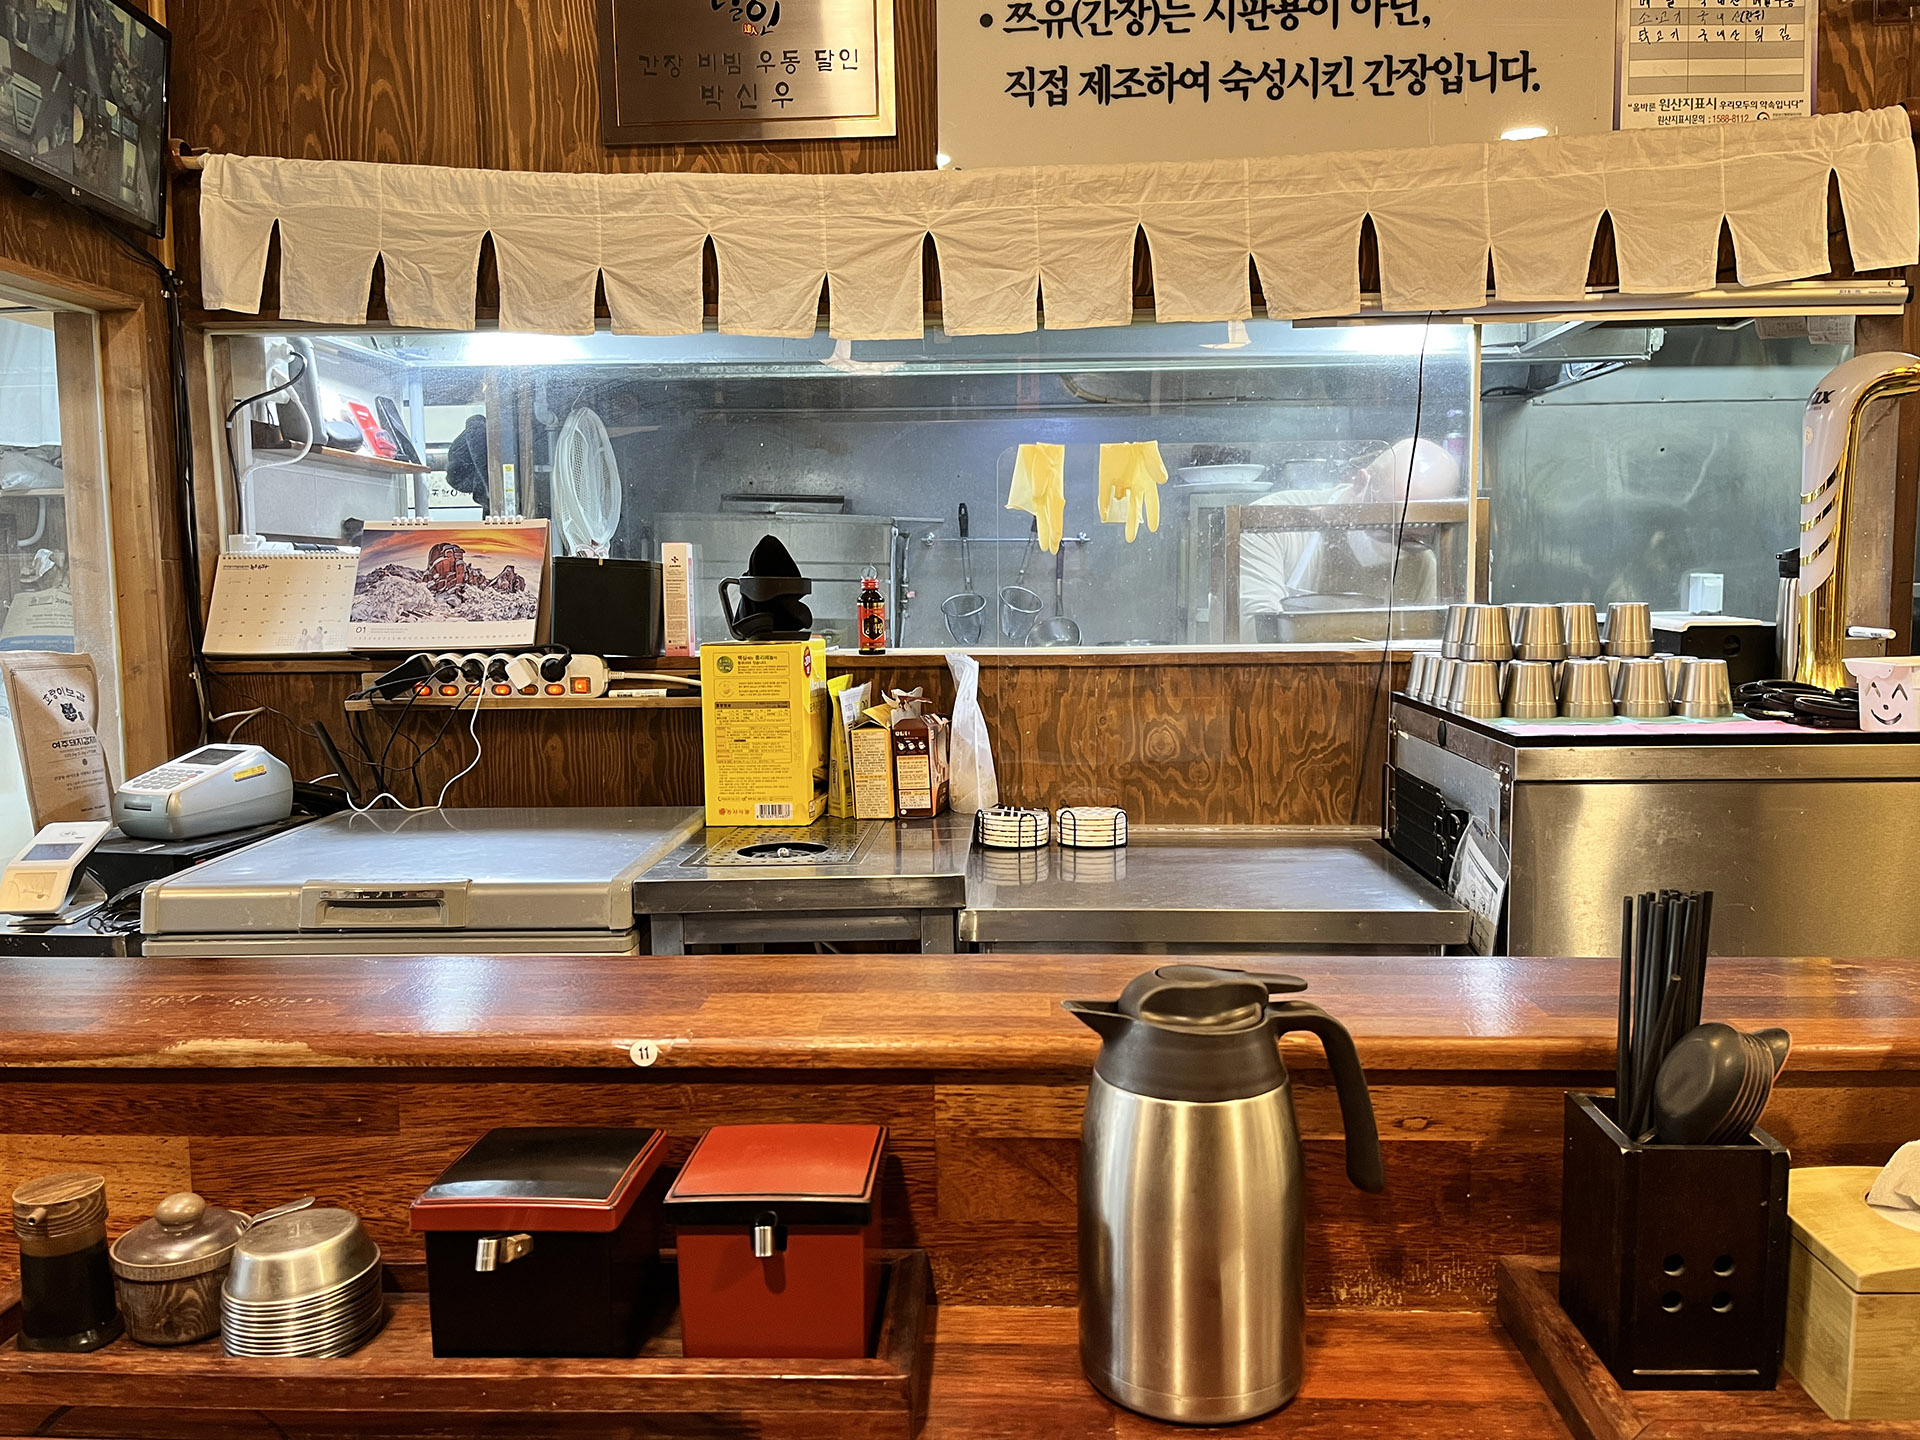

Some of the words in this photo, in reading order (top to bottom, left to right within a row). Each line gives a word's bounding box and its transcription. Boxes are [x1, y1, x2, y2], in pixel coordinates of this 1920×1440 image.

[1002, 0, 1195, 39] 쯔유(간장)는
[639, 54, 683, 78] 간장
[697, 52, 741, 75] 비빔
[757, 49, 800, 74] 우동
[815, 49, 858, 71] 달인
[1004, 66, 1068, 108] 직접
[1078, 61, 1210, 106] 제조하여
[1218, 55, 1354, 102] 숙성시킨
[1362, 50, 1541, 96] 간장입니다.
[1659, 97, 1717, 111] 원산지표시
[355, 626, 366, 634] 01
[638, 1046, 649, 1060] 11
